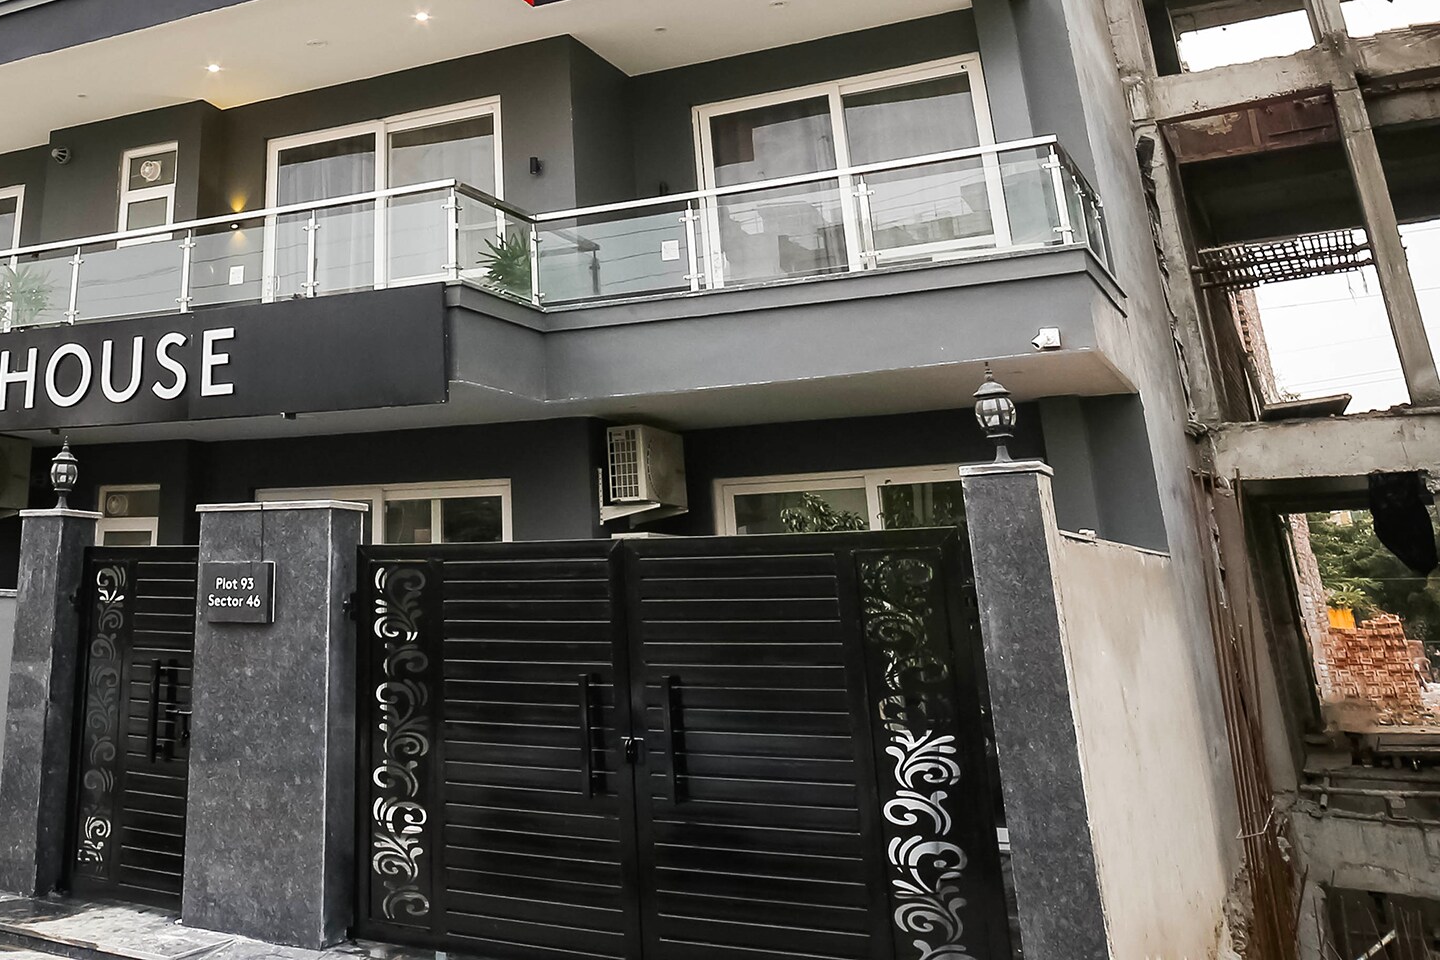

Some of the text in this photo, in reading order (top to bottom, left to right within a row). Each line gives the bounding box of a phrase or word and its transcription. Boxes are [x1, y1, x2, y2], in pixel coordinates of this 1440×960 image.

[215, 577, 254, 590] Plot 93
[208, 594, 261, 608] Sector 46
